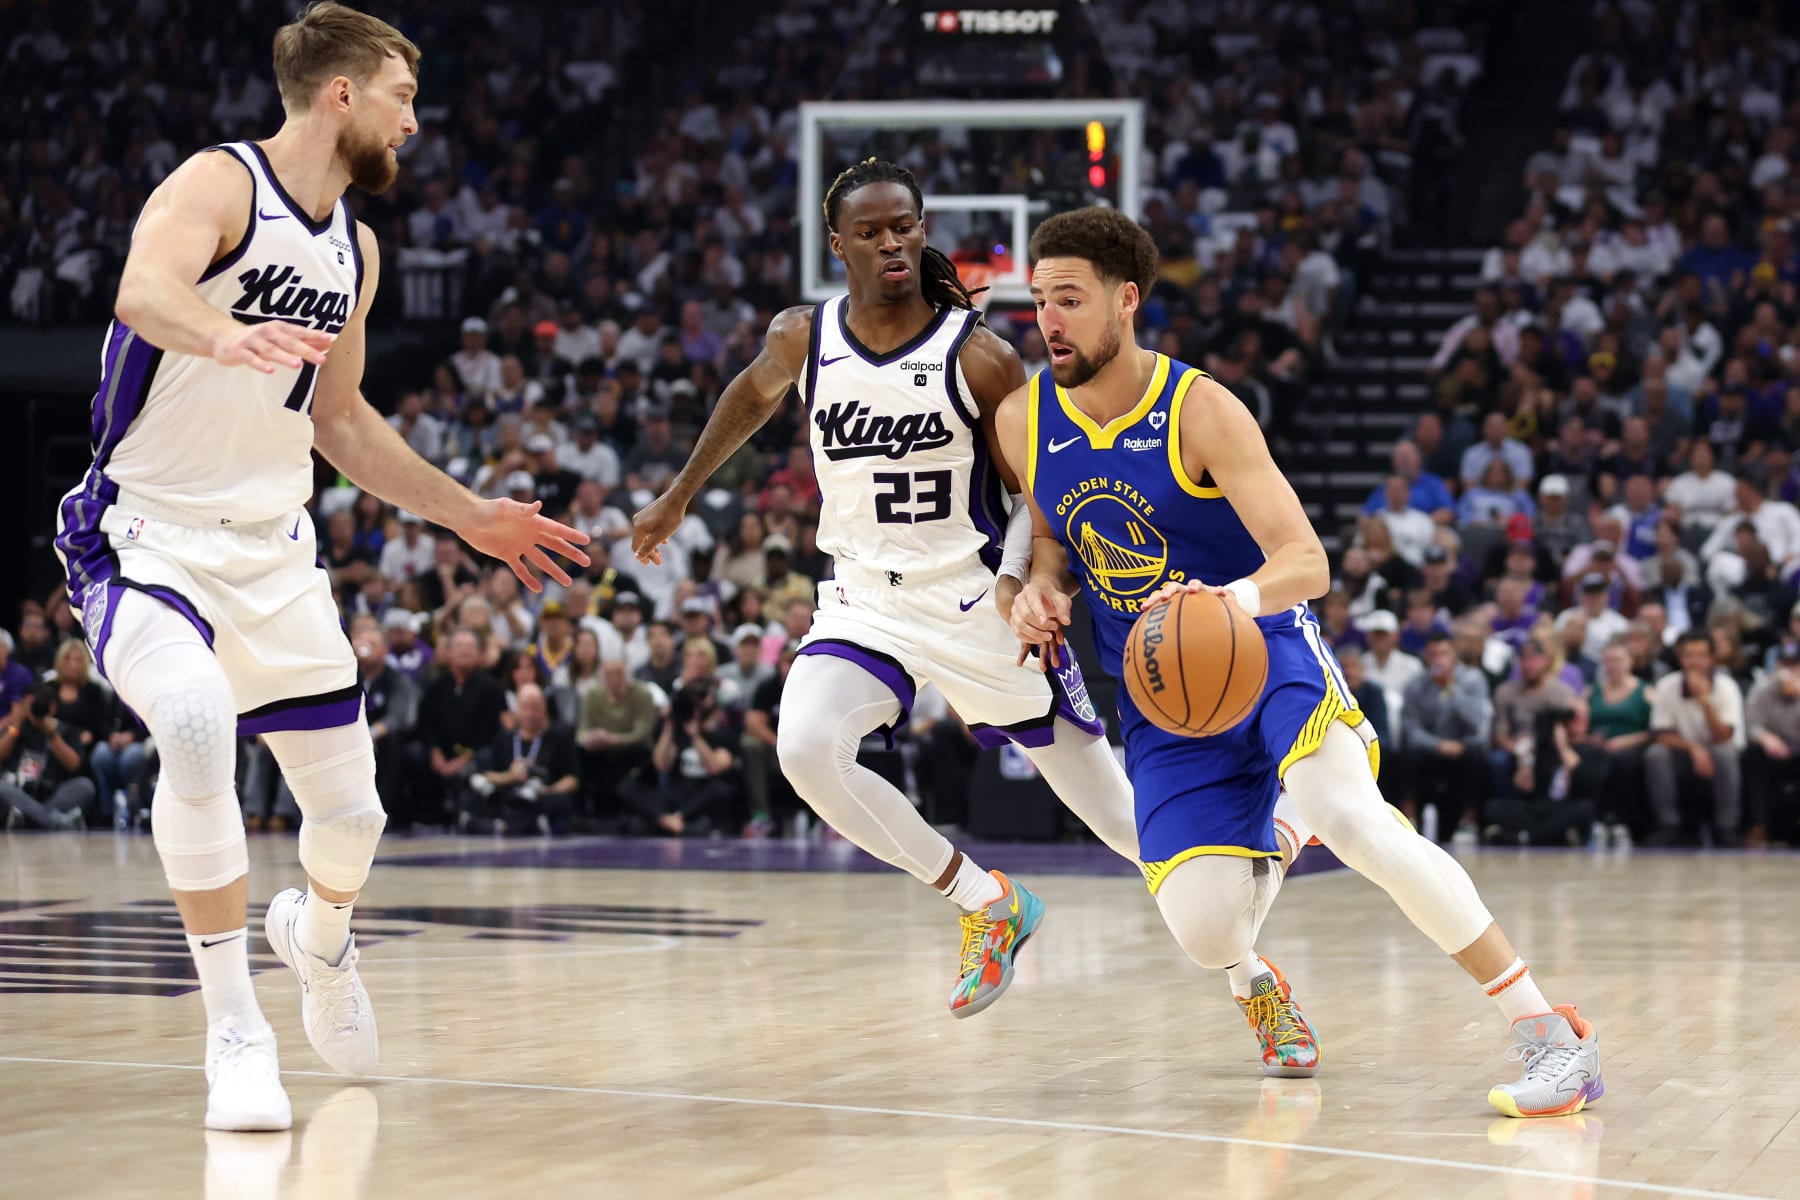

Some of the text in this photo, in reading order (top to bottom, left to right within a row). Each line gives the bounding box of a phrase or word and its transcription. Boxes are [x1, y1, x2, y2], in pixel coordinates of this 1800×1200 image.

[959, 10, 1058, 33] TISSOT
[230, 264, 350, 334] Kings
[900, 361, 943, 373] dialpad
[815, 400, 954, 461] Kings
[1123, 438, 1162, 450] Rakuten
[873, 470, 952, 524] 23
[1056, 477, 1155, 517] GOLDEN STATE
[1085, 569, 1185, 613] WARRS
[1143, 601, 1172, 695] Wilson
